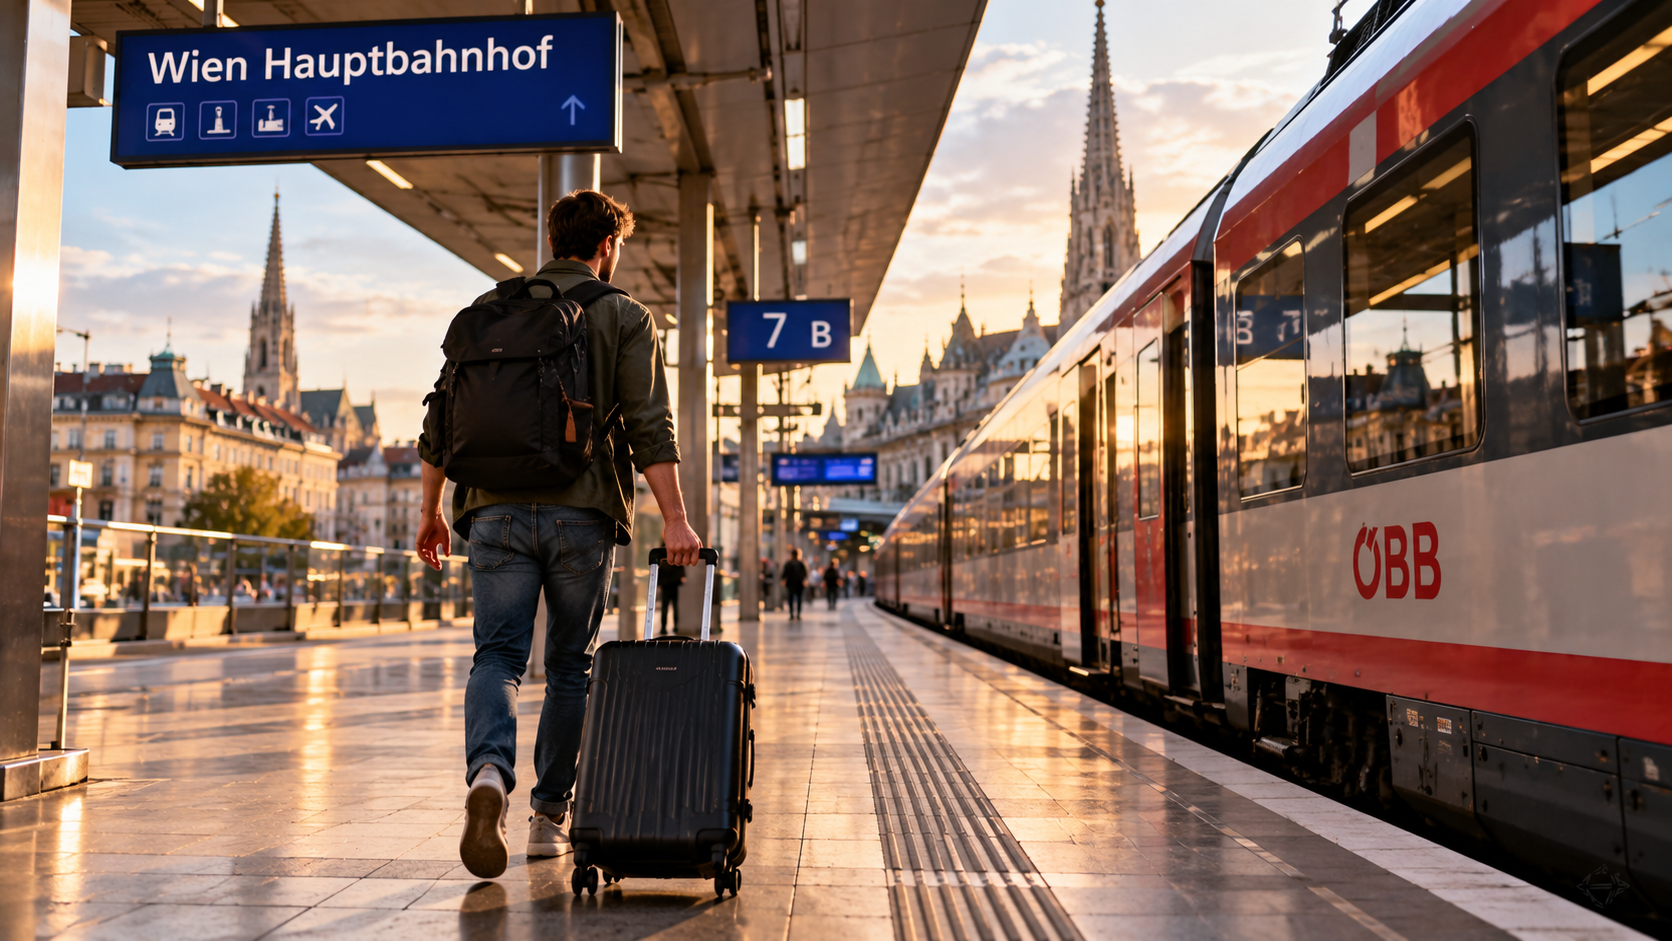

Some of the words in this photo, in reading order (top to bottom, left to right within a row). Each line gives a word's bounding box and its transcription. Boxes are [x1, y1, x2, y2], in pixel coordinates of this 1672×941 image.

[148, 49, 247, 84] Wien
[264, 34, 554, 86] Hauptbahnhof
[763, 312, 787, 348] 7
[811, 320, 832, 348] B
[1353, 521, 1442, 600] ÖBB
